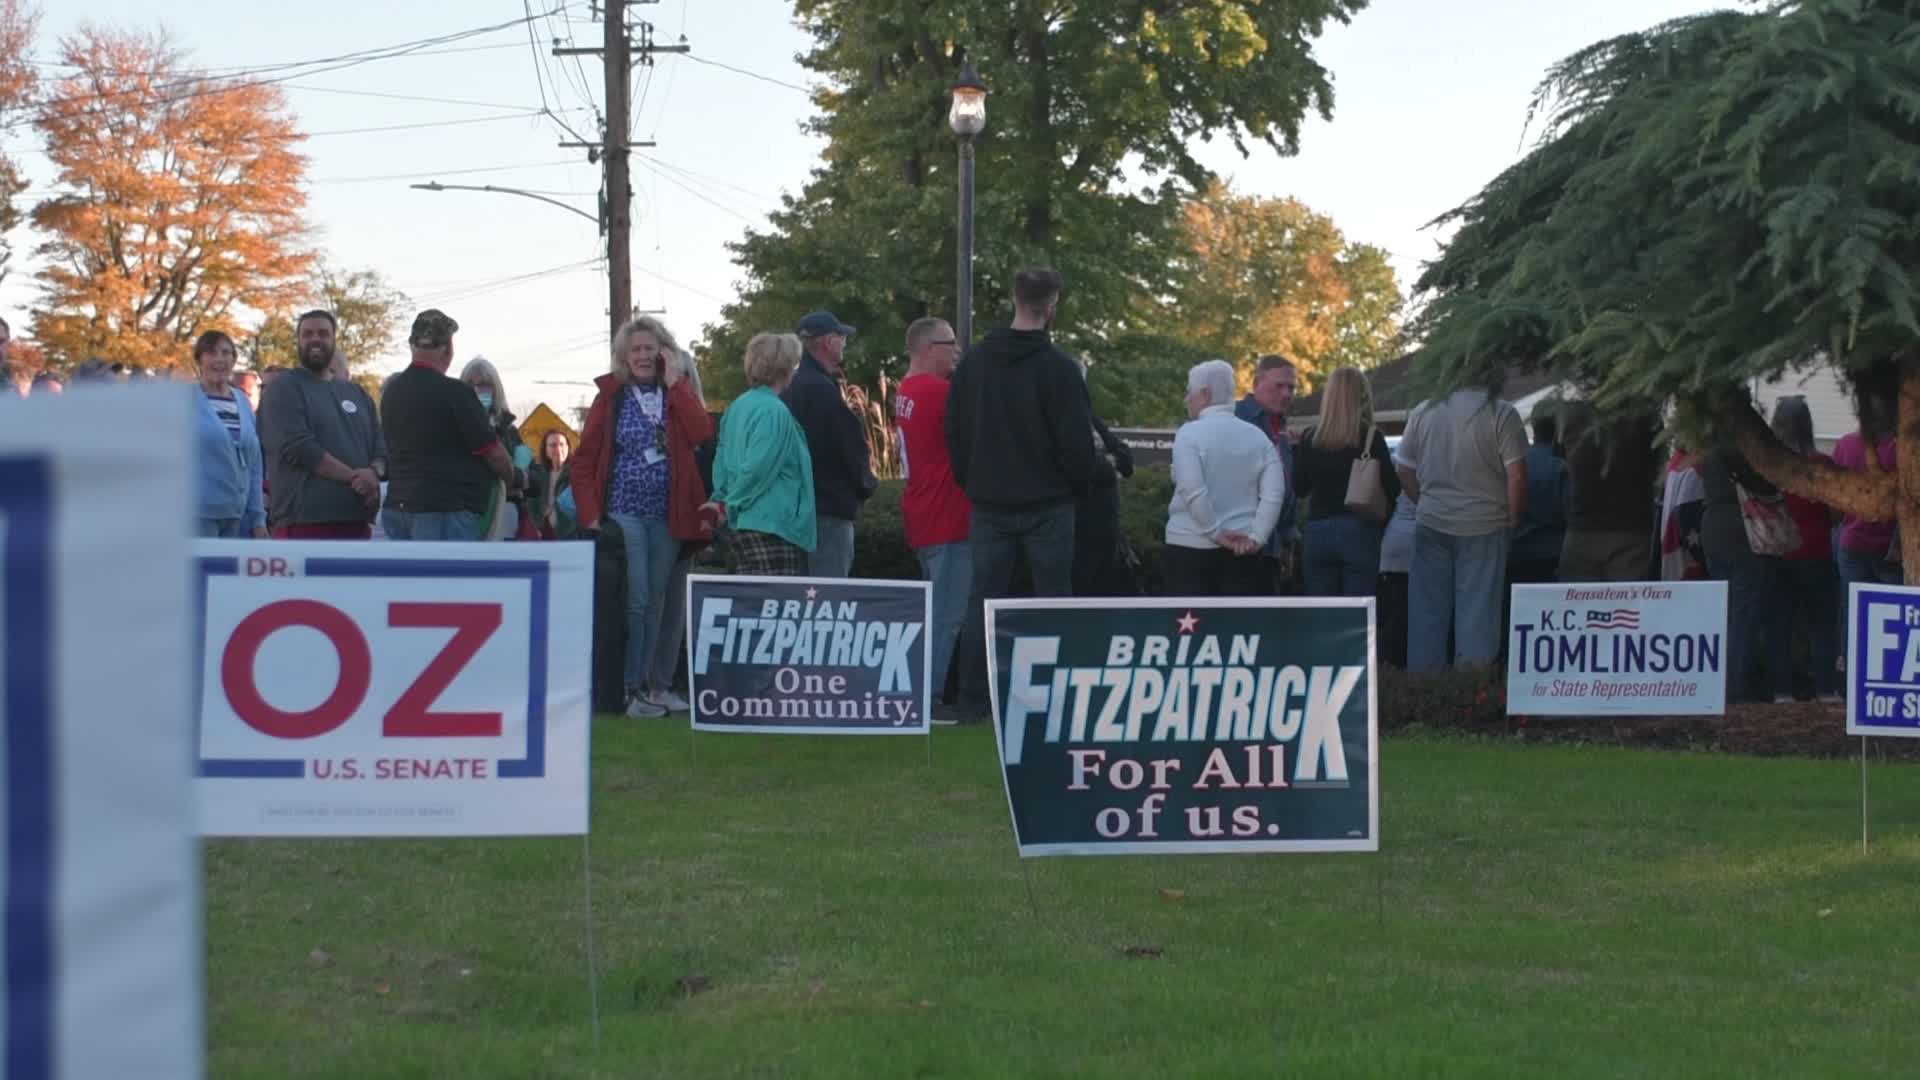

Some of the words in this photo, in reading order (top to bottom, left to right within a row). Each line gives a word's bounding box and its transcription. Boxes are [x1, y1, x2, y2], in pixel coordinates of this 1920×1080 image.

[246, 557, 296, 577] DR.
[1565, 587, 1638, 601] Bensalem's
[1641, 586, 1672, 600] Own
[760, 599, 858, 620] BRIAN
[1540, 610, 1582, 631] K.C.
[694, 597, 922, 692] FITZPATRICK
[1106, 634, 1260, 666] BRIAN
[1514, 624, 1720, 673] TOMLINSON
[220, 598, 503, 739] OZ
[774, 667, 847, 694] One
[1532, 682, 1548, 697] for
[1551, 679, 1588, 697] State
[1590, 679, 1697, 700] Representative
[1865, 690, 1897, 717] for
[698, 690, 918, 725] Community.
[1004, 636, 1365, 782] FITZPATRICK
[312, 758, 365, 779] U.S.
[375, 758, 488, 779] SENATE
[1067, 749, 1180, 789] For
[1193, 745, 1288, 789] All
[1095, 793, 1166, 838] of
[1184, 804, 1280, 837] us.
